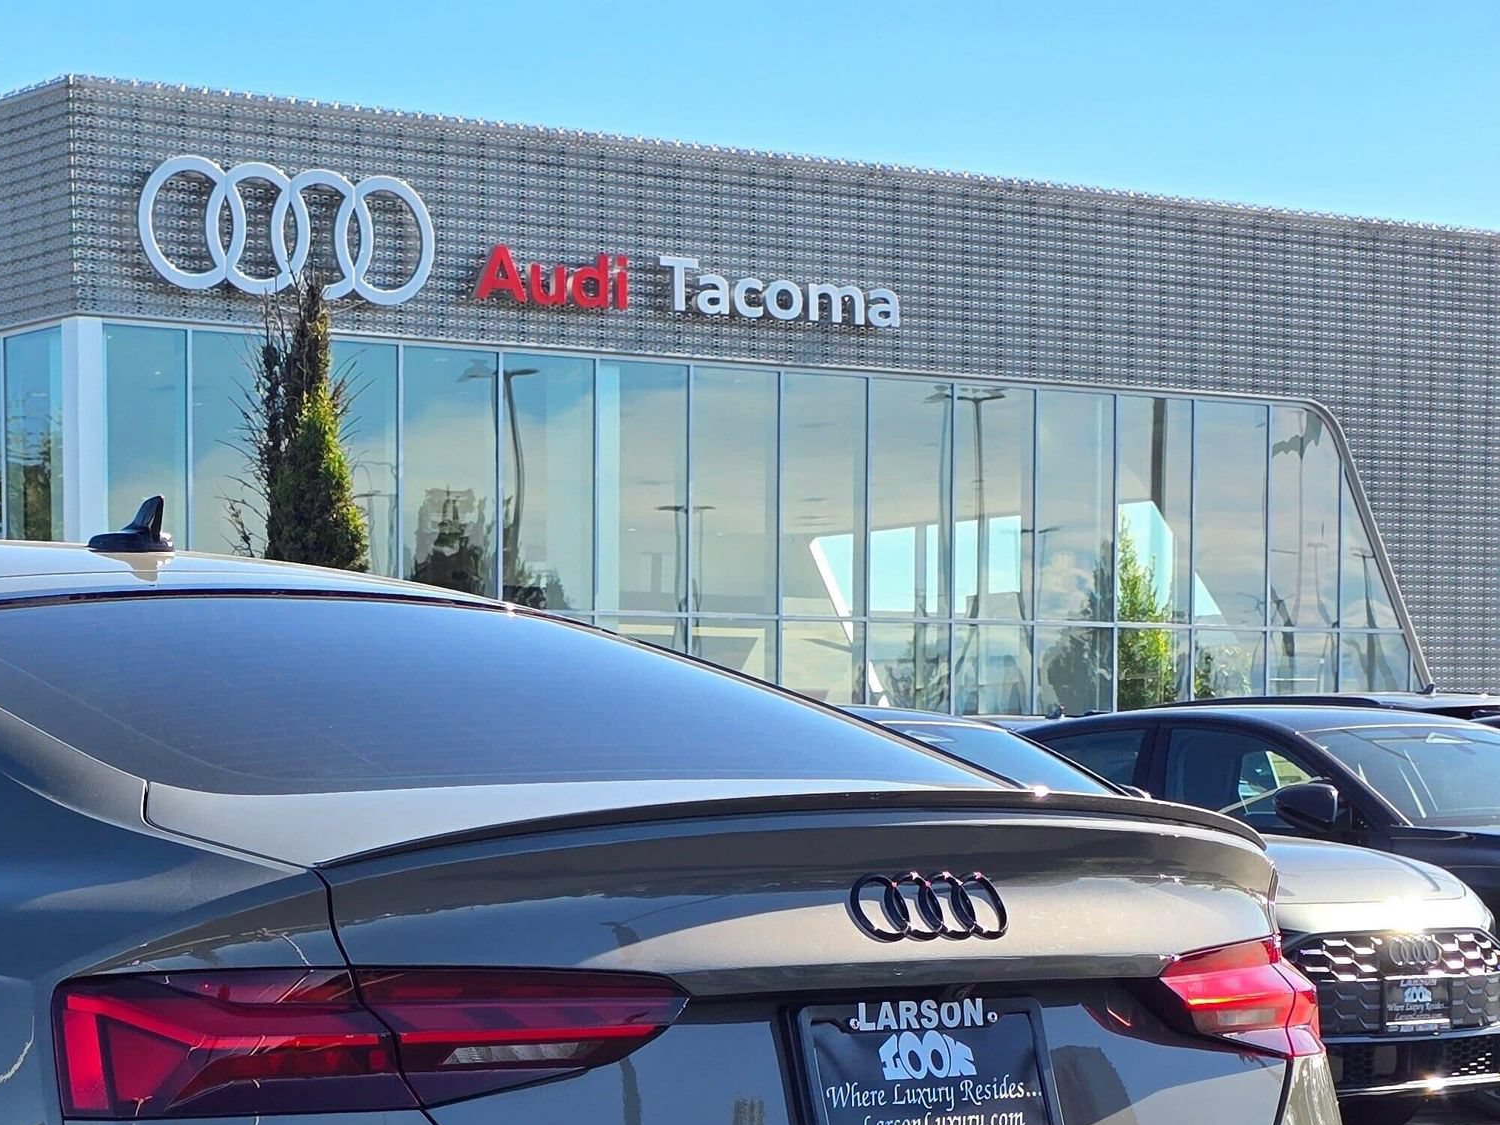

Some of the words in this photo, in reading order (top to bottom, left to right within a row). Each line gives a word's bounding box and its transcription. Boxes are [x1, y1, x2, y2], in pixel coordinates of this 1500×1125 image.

[473, 243, 629, 310] Audi
[659, 256, 900, 328] Tacoma
[858, 998, 984, 1031] LARSON
[826, 1082, 886, 1108] Where
[892, 1083, 955, 1111] Luxury
[959, 1074, 1043, 1106] Resides...
